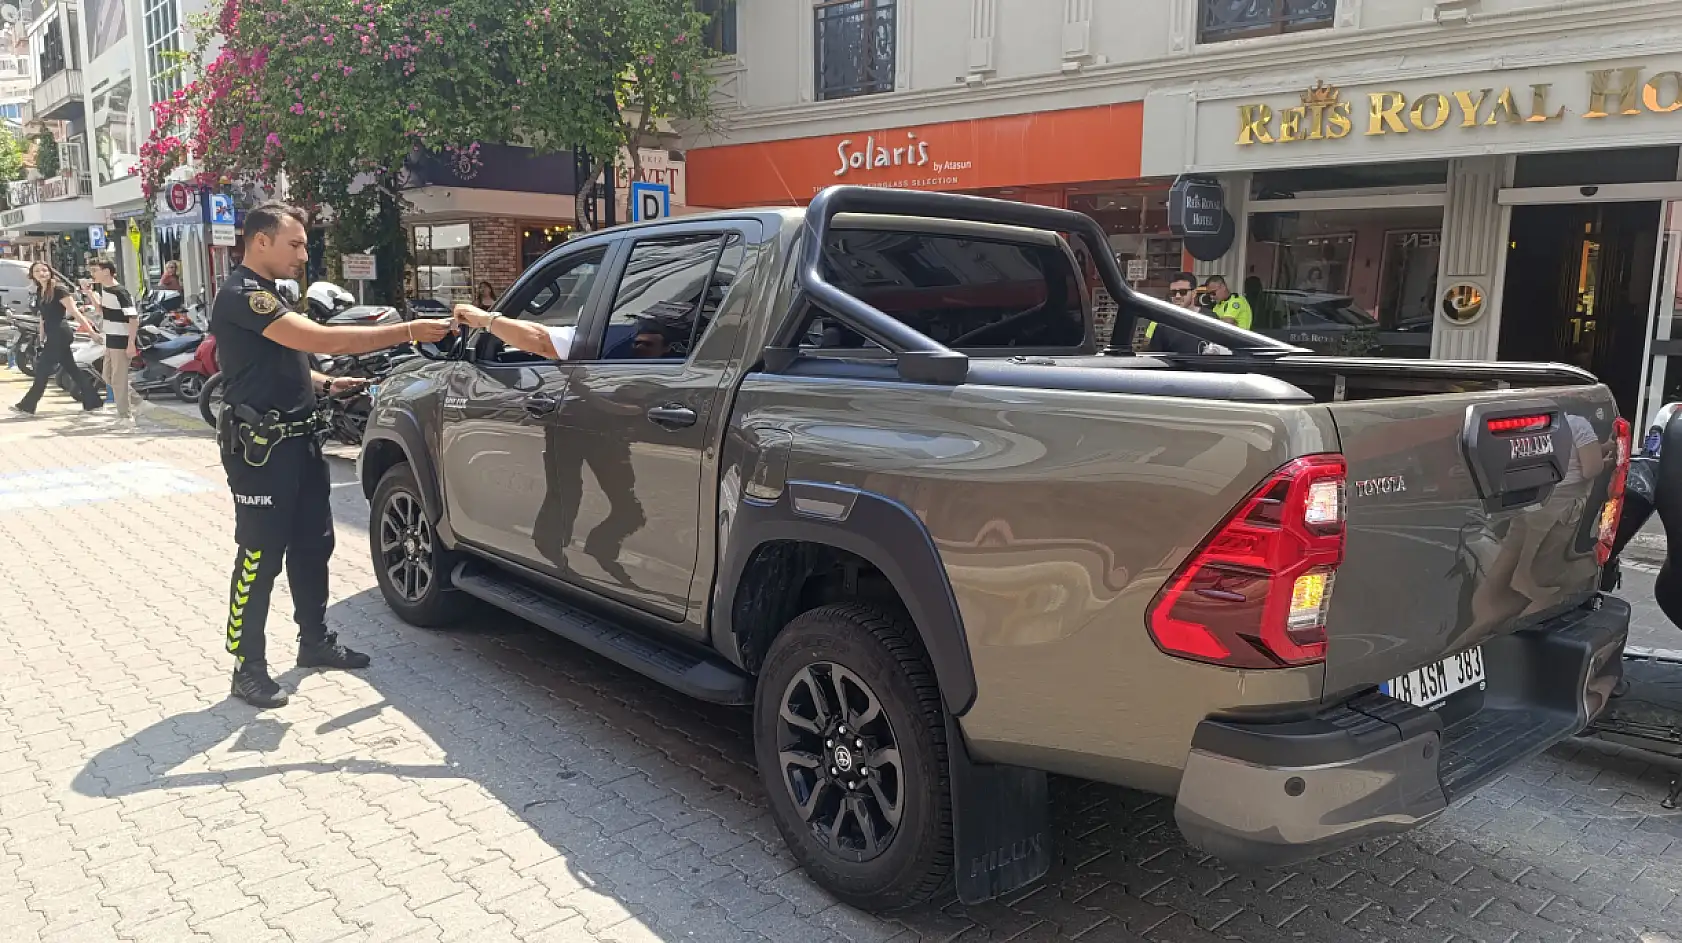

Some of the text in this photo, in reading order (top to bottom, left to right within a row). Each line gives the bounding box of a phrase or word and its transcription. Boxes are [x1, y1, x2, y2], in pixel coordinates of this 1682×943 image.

[1235, 101, 1352, 145] REIS
[1364, 84, 1565, 136] ROYAL
[833, 131, 929, 176] Solaris
[933, 160, 972, 173] by Atasun
[911, 176, 959, 187] SELECTION
[643, 193, 660, 221] D
[1193, 212, 1214, 226] HOTEL
[1355, 476, 1407, 497] TOYOTA
[1419, 660, 1448, 701] ASM
[1454, 646, 1481, 683] 383
